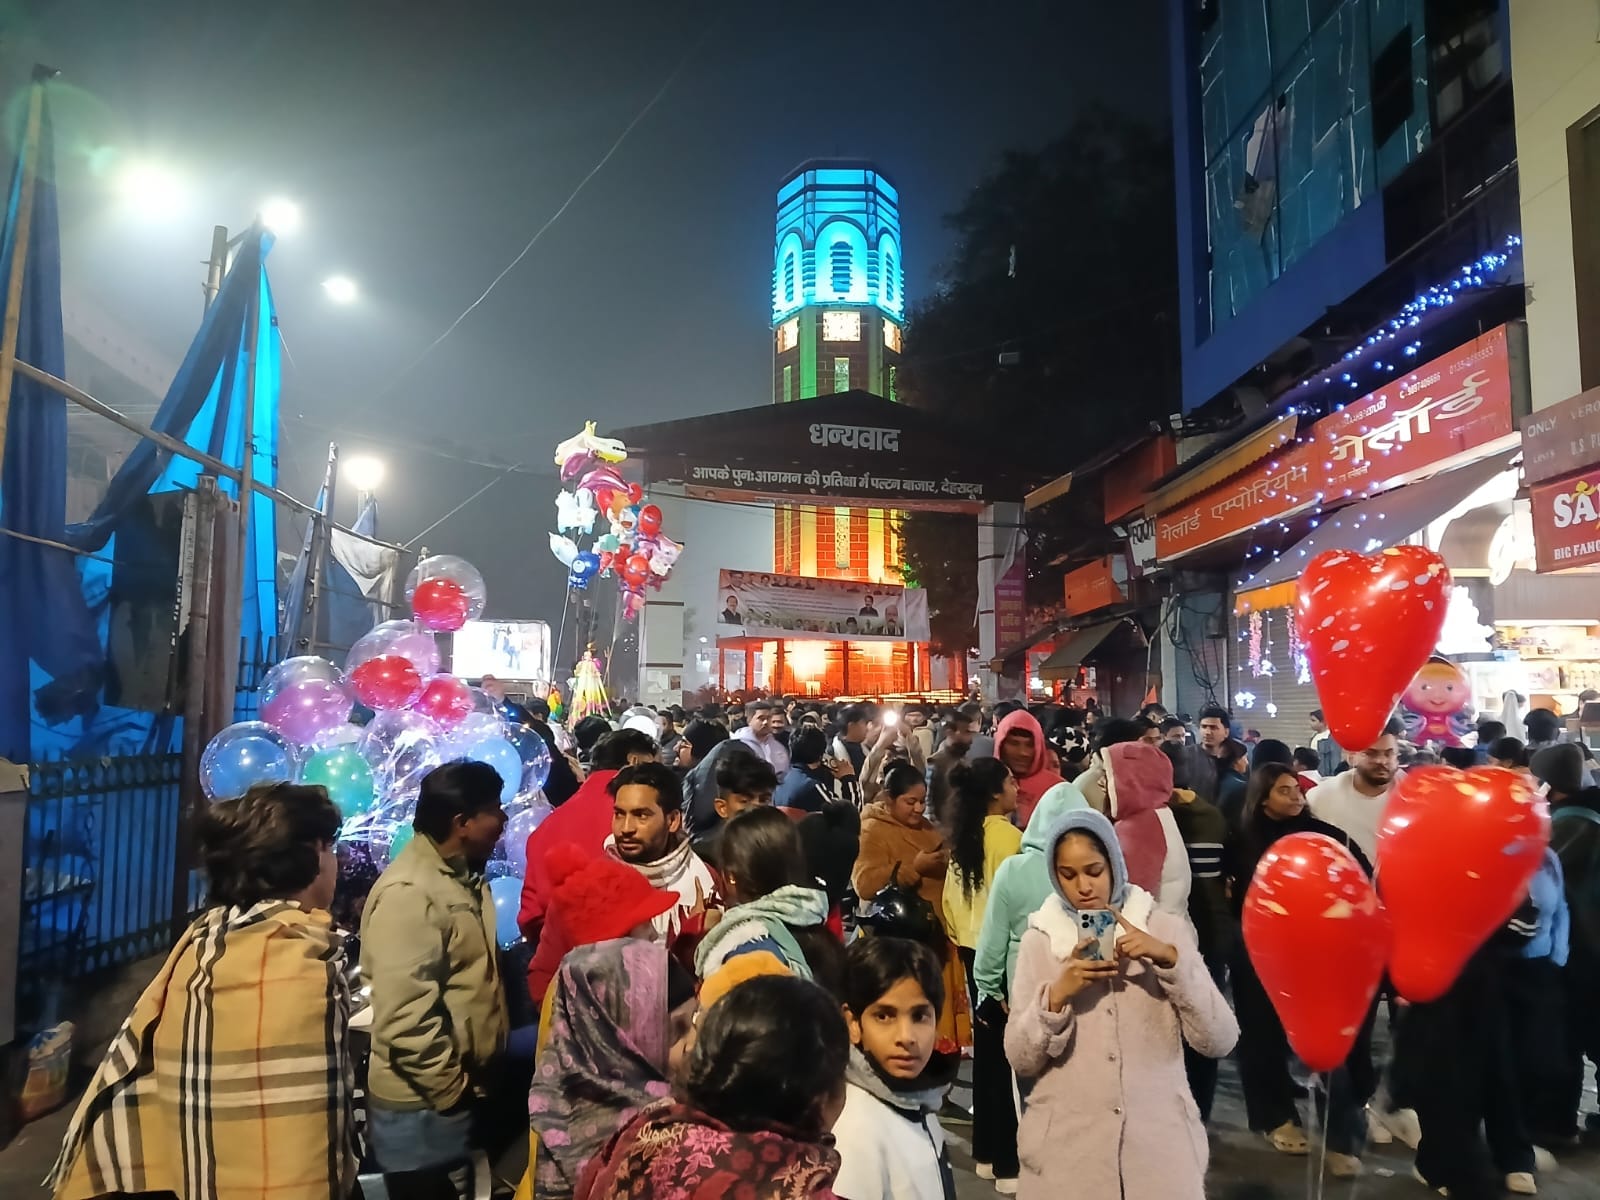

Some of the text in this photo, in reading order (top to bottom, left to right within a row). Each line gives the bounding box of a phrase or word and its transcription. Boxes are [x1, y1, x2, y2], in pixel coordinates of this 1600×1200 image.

[808, 423, 901, 452] धन्यवाद
[1528, 416, 1557, 438] ONLY
[692, 465, 731, 480] आपके
[803, 470, 820, 486] की
[1211, 463, 1309, 521] एम्पोरियम
[1553, 484, 1600, 528] SA
[1554, 546, 1572, 560] BIG
